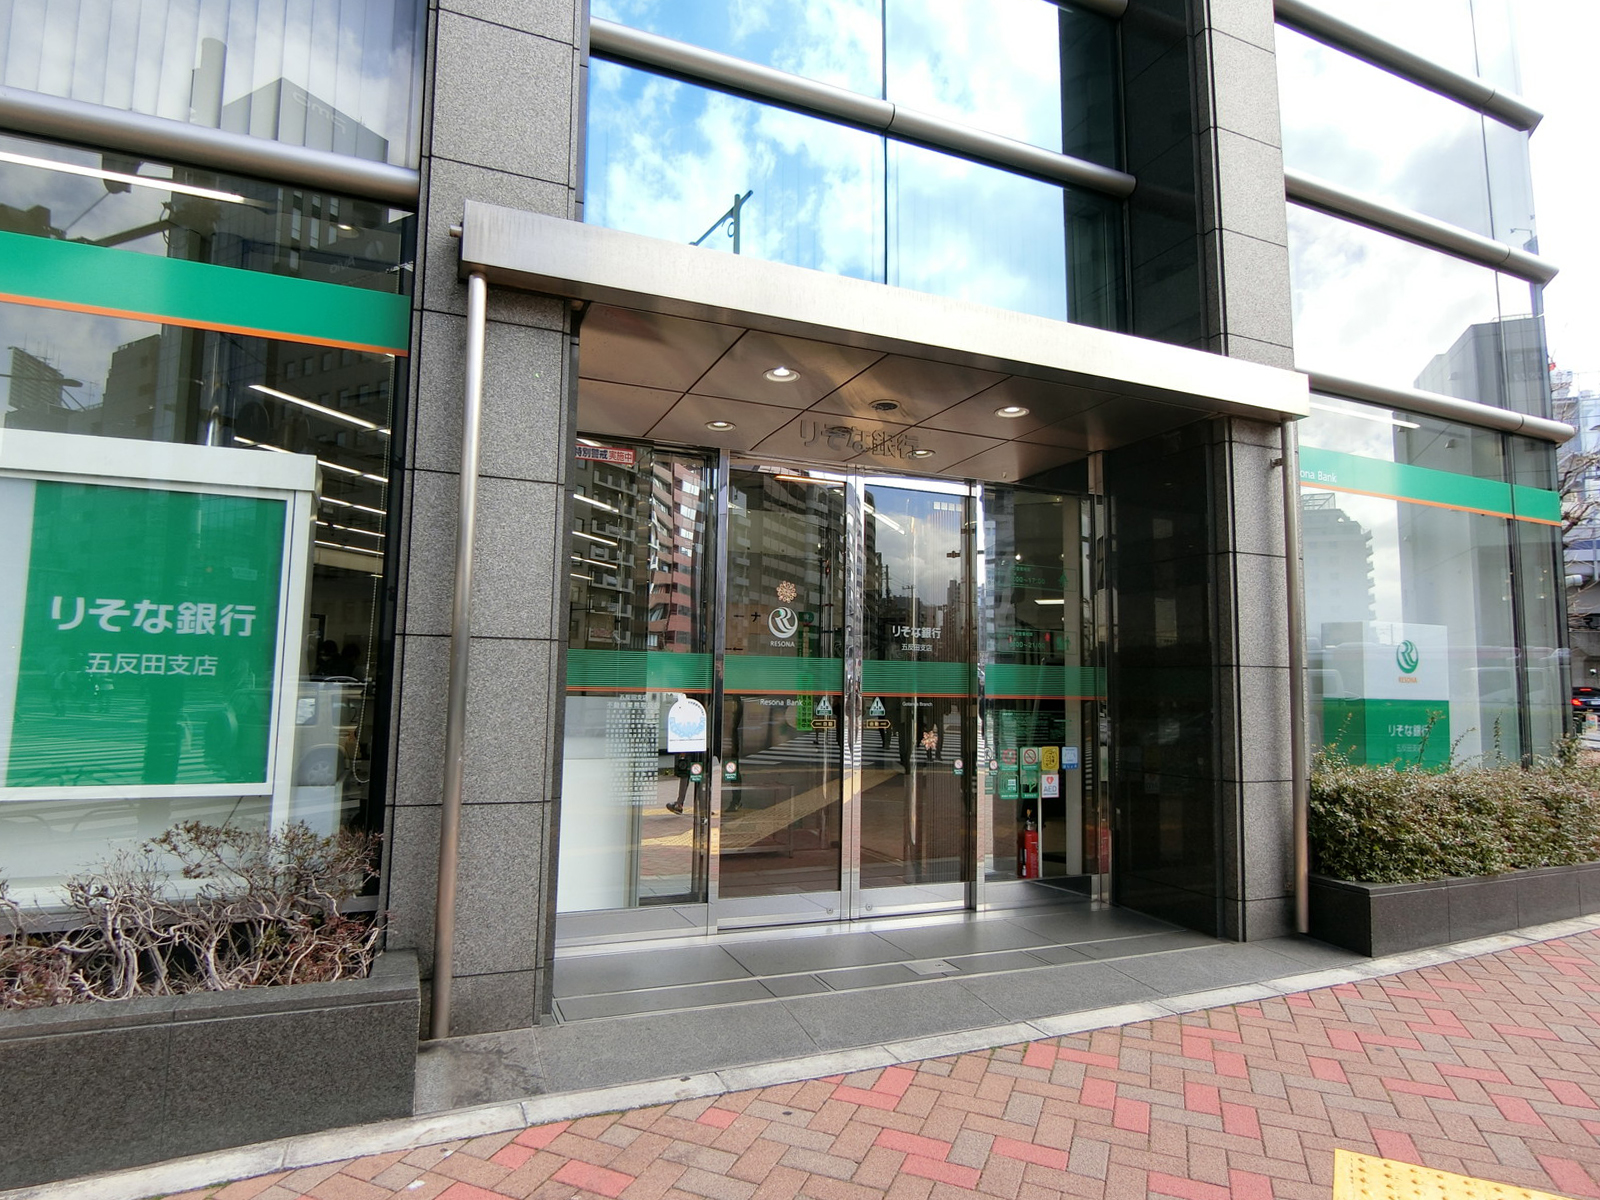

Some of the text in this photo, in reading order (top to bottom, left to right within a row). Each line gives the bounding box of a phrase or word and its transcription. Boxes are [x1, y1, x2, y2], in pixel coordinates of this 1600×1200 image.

[1317, 470, 1338, 483] Bank
[51, 596, 256, 636] りそな銀行
[892, 625, 942, 639] りそな銀行
[770, 640, 796, 648] RESONA
[901, 643, 933, 652] 五反田支店
[85, 652, 219, 677] 五反田支店
[760, 698, 804, 707] Resona Bank
[1043, 785, 1058, 793] AED
